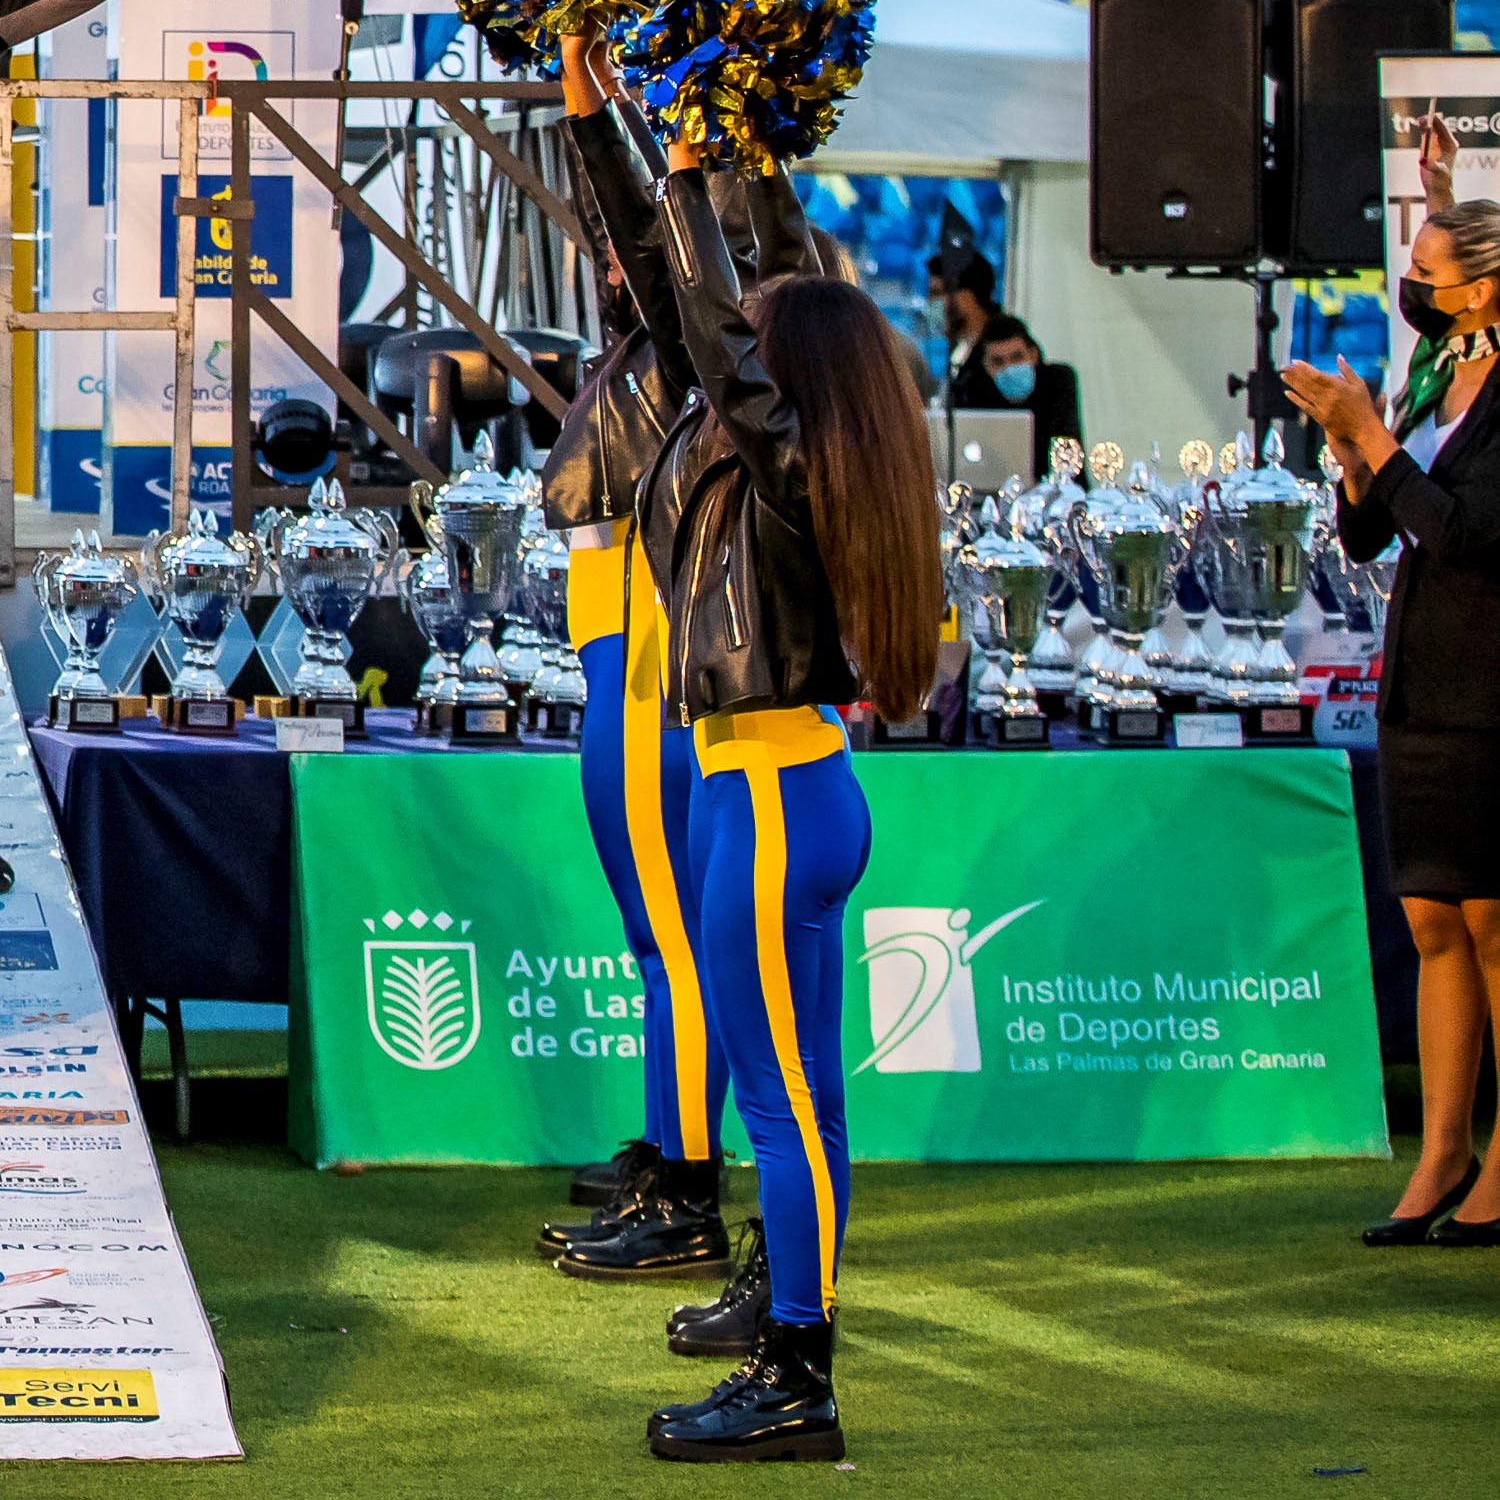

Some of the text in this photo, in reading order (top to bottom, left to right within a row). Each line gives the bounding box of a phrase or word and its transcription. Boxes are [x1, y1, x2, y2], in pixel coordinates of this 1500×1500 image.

[506, 986, 646, 1019] de Las
[1002, 970, 1322, 1007] Instituto Municipal
[510, 1025, 646, 1058] de Gra
[1005, 1011, 1221, 1050] de Deportes
[1008, 1047, 1327, 1073] Las Palmas de Gran Canaria
[24, 1378, 119, 1394] Servi
